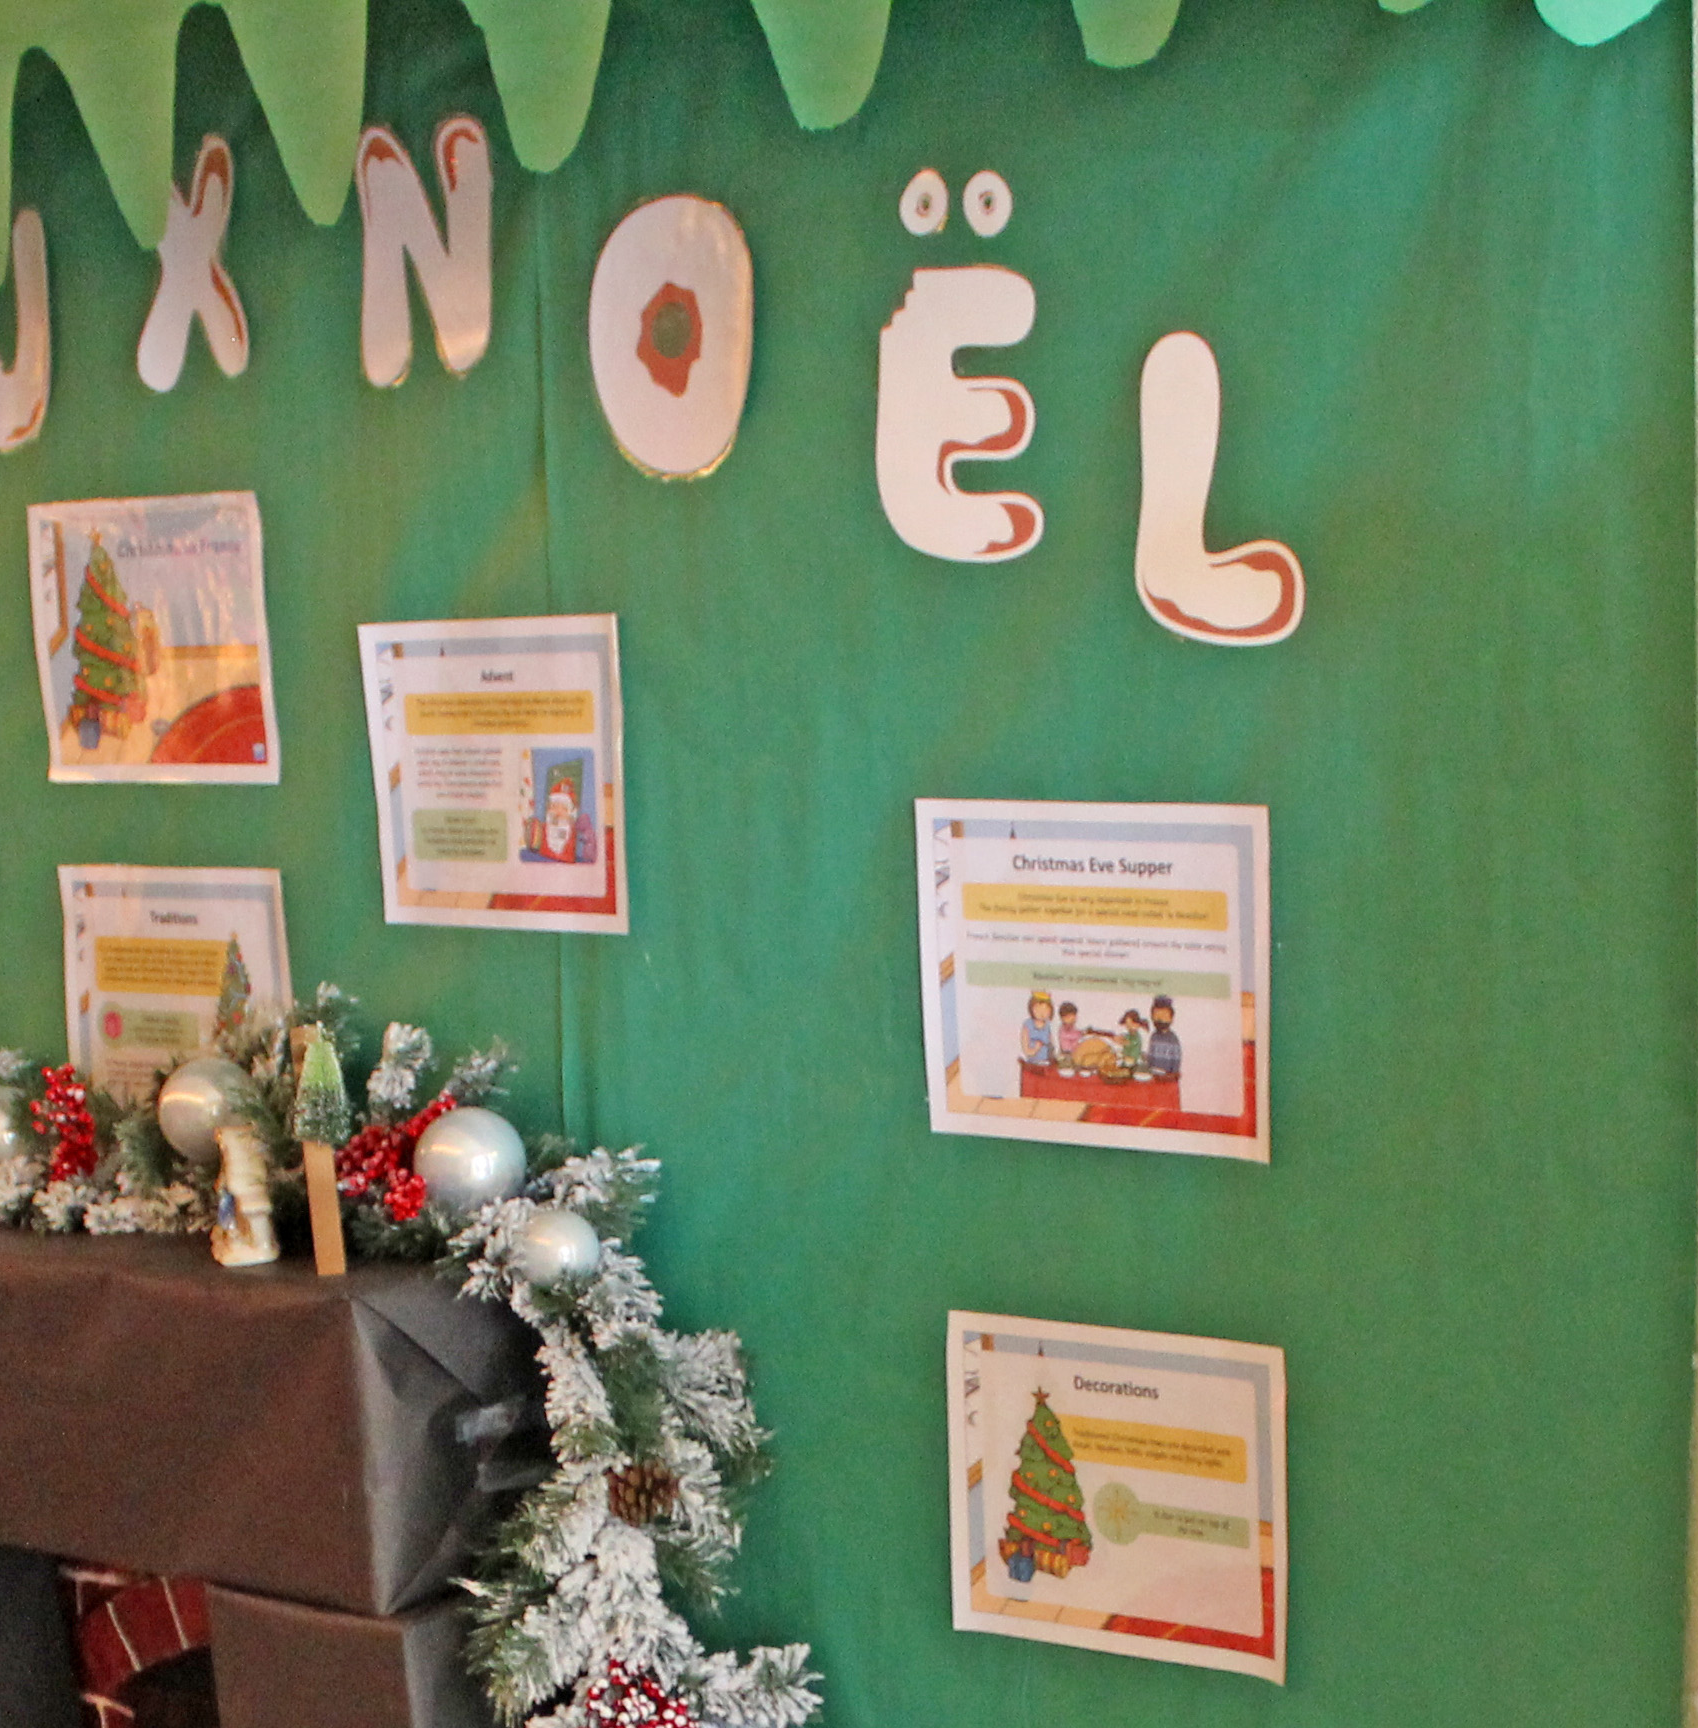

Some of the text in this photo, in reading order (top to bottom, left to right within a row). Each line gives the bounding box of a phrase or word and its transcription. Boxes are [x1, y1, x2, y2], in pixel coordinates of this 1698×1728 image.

[356, 115, 1304, 647] NOËL
[480, 668, 514, 683] Advent
[1012, 854, 1173, 878] Christmas Eve Supper
[149, 910, 199, 926] Traditions
[1073, 1375, 1160, 1400] Decorations
